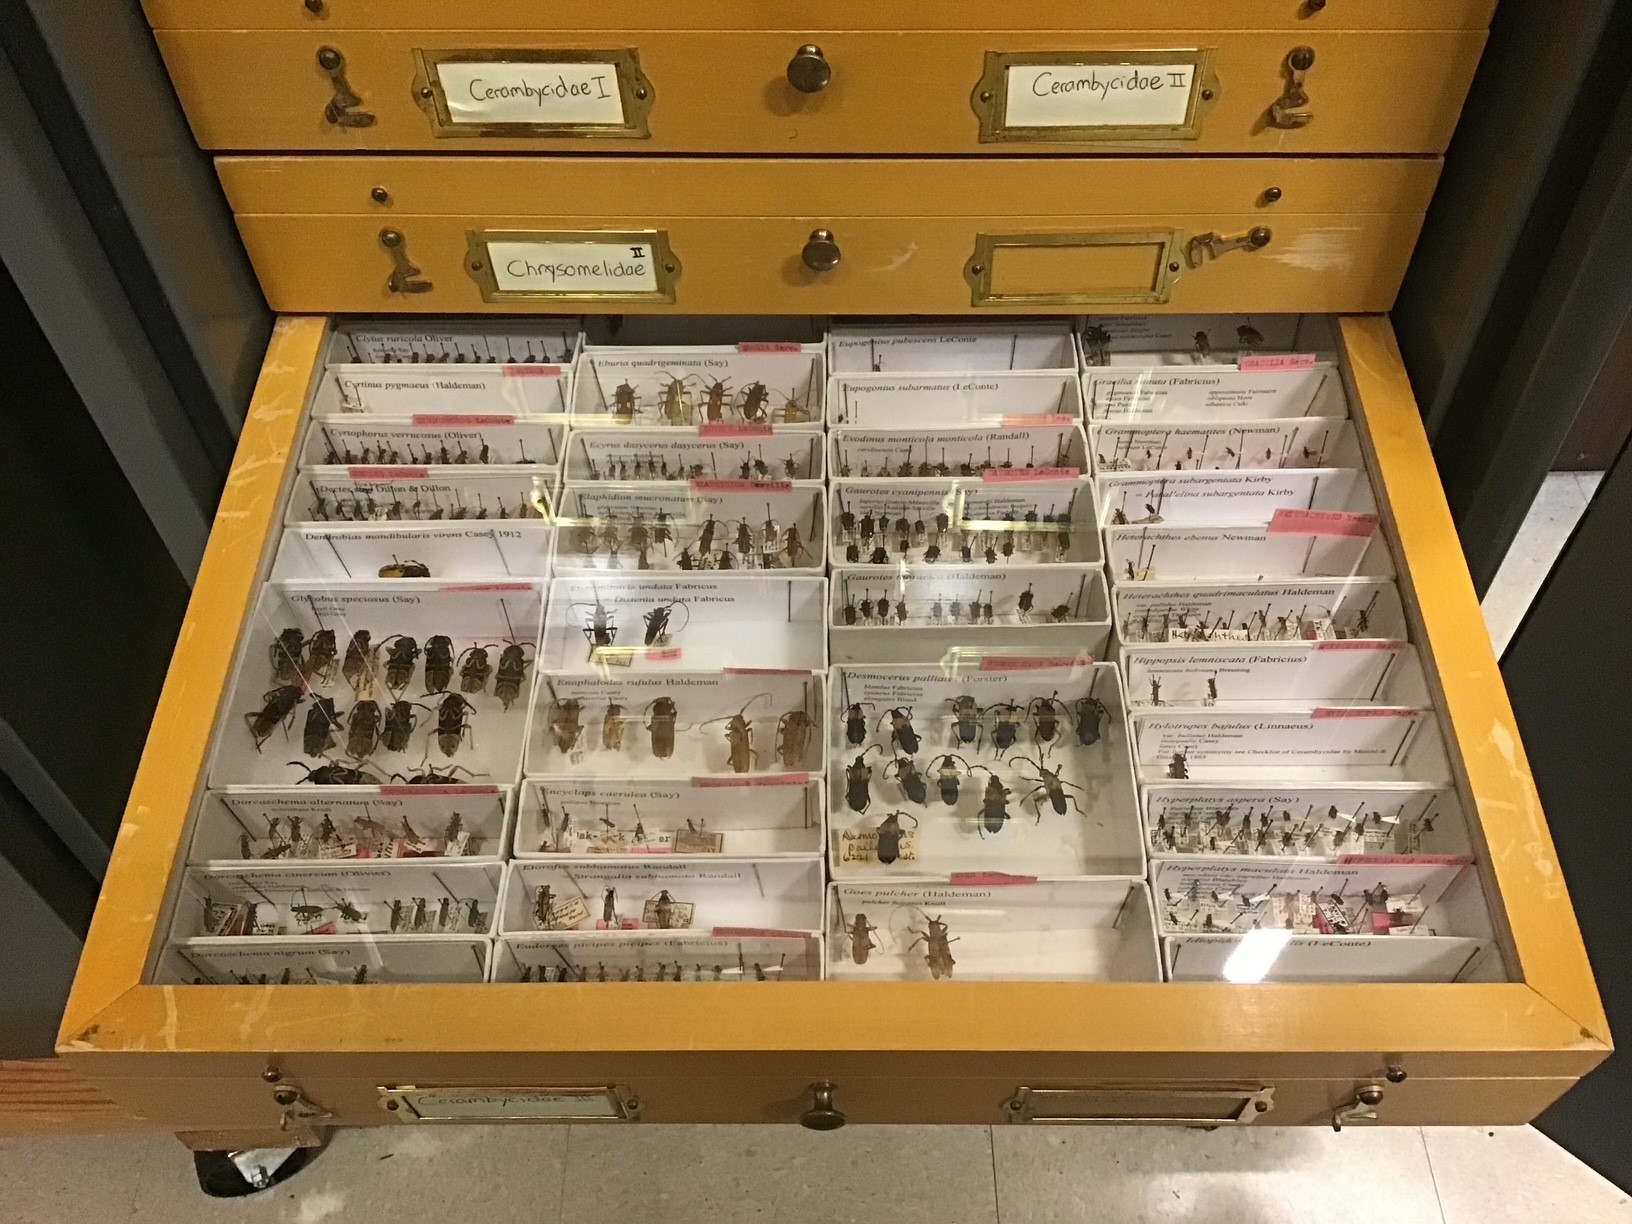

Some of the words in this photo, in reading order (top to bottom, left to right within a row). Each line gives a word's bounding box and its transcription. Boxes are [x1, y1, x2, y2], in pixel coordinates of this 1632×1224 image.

[469, 75, 591, 106] Cerambycidae
[592, 76, 611, 99] I
[1032, 72, 1163, 100] Cerambycidae
[1167, 72, 1186, 88] II
[630, 247, 645, 258] II
[507, 260, 646, 283] Chrysomelidae
[355, 335, 383, 343] Clytus
[939, 336, 977, 344] LeConte
[631, 360, 702, 369] quadrigeminata
[704, 359, 729, 368] (Say)
[432, 381, 486, 390] (Haldeman)
[1169, 377, 1220, 386] (Fabricius)
[952, 383, 999, 391] (LeConte)
[331, 429, 388, 438] Cyrtophorus
[444, 431, 482, 440] (Oliver)
[1229, 426, 1280, 435] (Newman)
[842, 435, 885, 443] Evodinus
[887, 435, 934, 443] monticola
[985, 432, 1030, 442] (Randall)
[719, 441, 744, 449] (Say)
[1245, 476, 1274, 484] Kirby
[421, 484, 450, 492] Dillon
[845, 487, 889, 495] Gaurotes
[1267, 488, 1296, 497] Kirby
[498, 530, 521, 538] 1912
[847, 573, 893, 581] Gaurotes
[392, 596, 421, 604] (Say)
[1134, 656, 1186, 665] Hippopsis
[1248, 655, 1308, 664] (Fabricius)
[847, 672, 910, 681] Desmocerus
[912, 674, 959, 683] palliatu
[961, 675, 1007, 683] (Forster)
[1254, 722, 1314, 731] (Linnaeus)
[650, 791, 680, 799] (Say)
[1156, 795, 1227, 805] Hyperplatys
[1268, 796, 1299, 804] (Say)
[1299, 868, 1359, 876] Haldeman
[843, 888, 871, 897] Goes
[874, 888, 920, 898] pulcher
[922, 890, 991, 898] (Haldeman)
